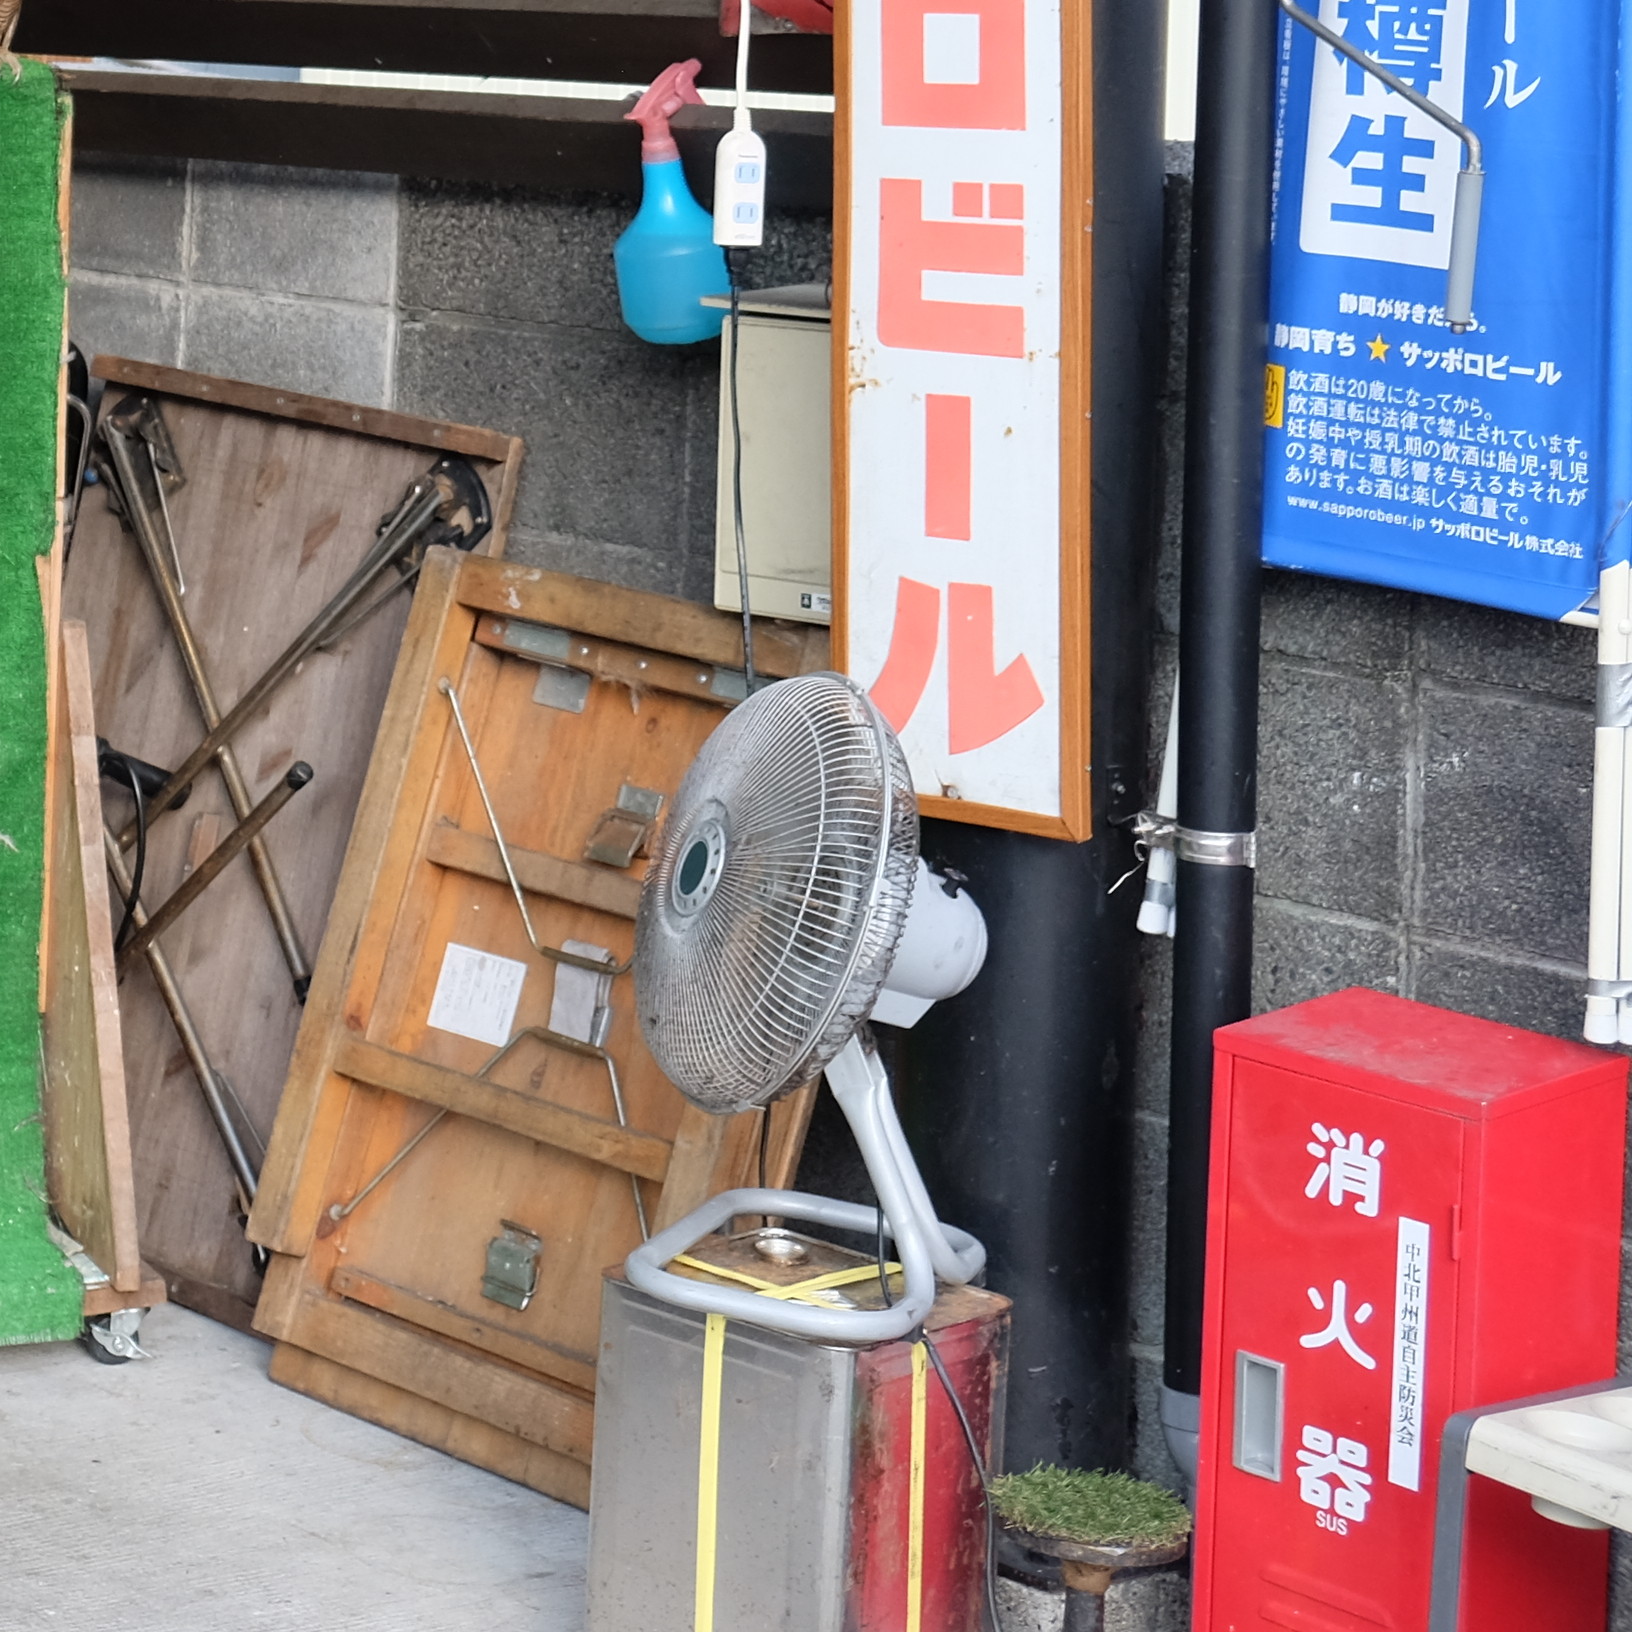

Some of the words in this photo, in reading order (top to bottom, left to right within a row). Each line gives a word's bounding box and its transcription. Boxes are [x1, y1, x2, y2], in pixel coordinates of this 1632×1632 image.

[1338, 292, 1487, 334] 静岡が好きだら。
[1274, 323, 1356, 357] 静岡育ち
[1400, 341, 1563, 386] サッポロビール
[1286, 393, 1589, 460] 飲酒運転は法律で禁止されています。
[1287, 369, 1493, 421] 飲酒は20歳になってから。
[1285, 441, 1587, 507] の発育に悪影響を与えるおそれが
[1286, 417, 1589, 485] 妊娠中や授乳期の飲酒は胎児・乳児
[1284, 466, 1529, 526] あります。お酒は楽しく適量で。
[1287, 493, 1426, 531] www.sapporobeer.jp
[1429, 518, 1585, 559] サッポロビール株式会社
[1296, 1122, 1385, 1525] 消火器
[1396, 1243, 1422, 1448] 中北甲州道自主防災会
[1315, 1509, 1349, 1536] SUS
